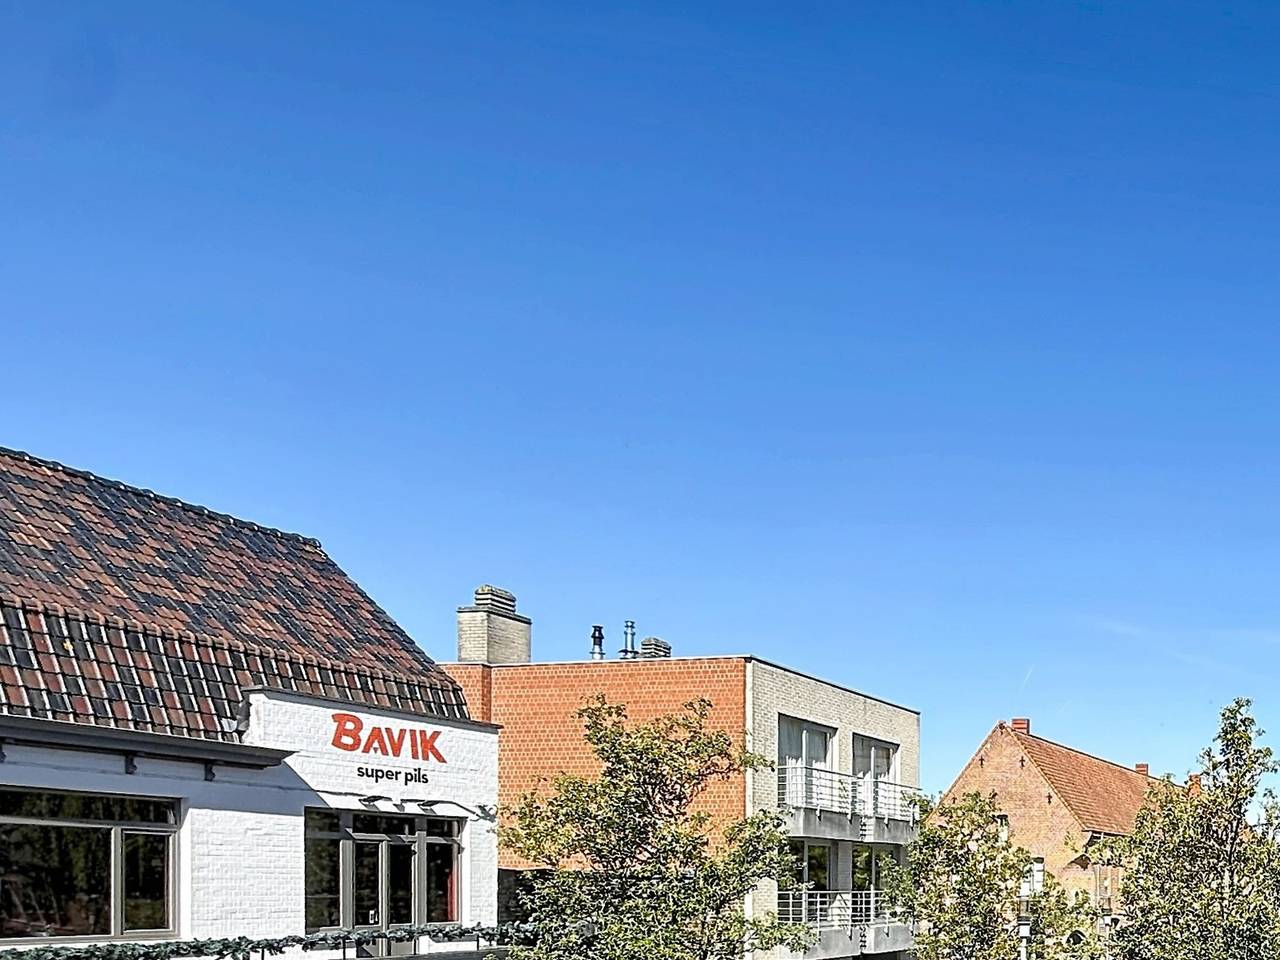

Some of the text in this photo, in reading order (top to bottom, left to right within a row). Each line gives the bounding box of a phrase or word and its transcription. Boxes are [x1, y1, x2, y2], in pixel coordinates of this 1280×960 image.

[331, 713, 448, 764] BAVIK
[357, 766, 429, 786] super pils
